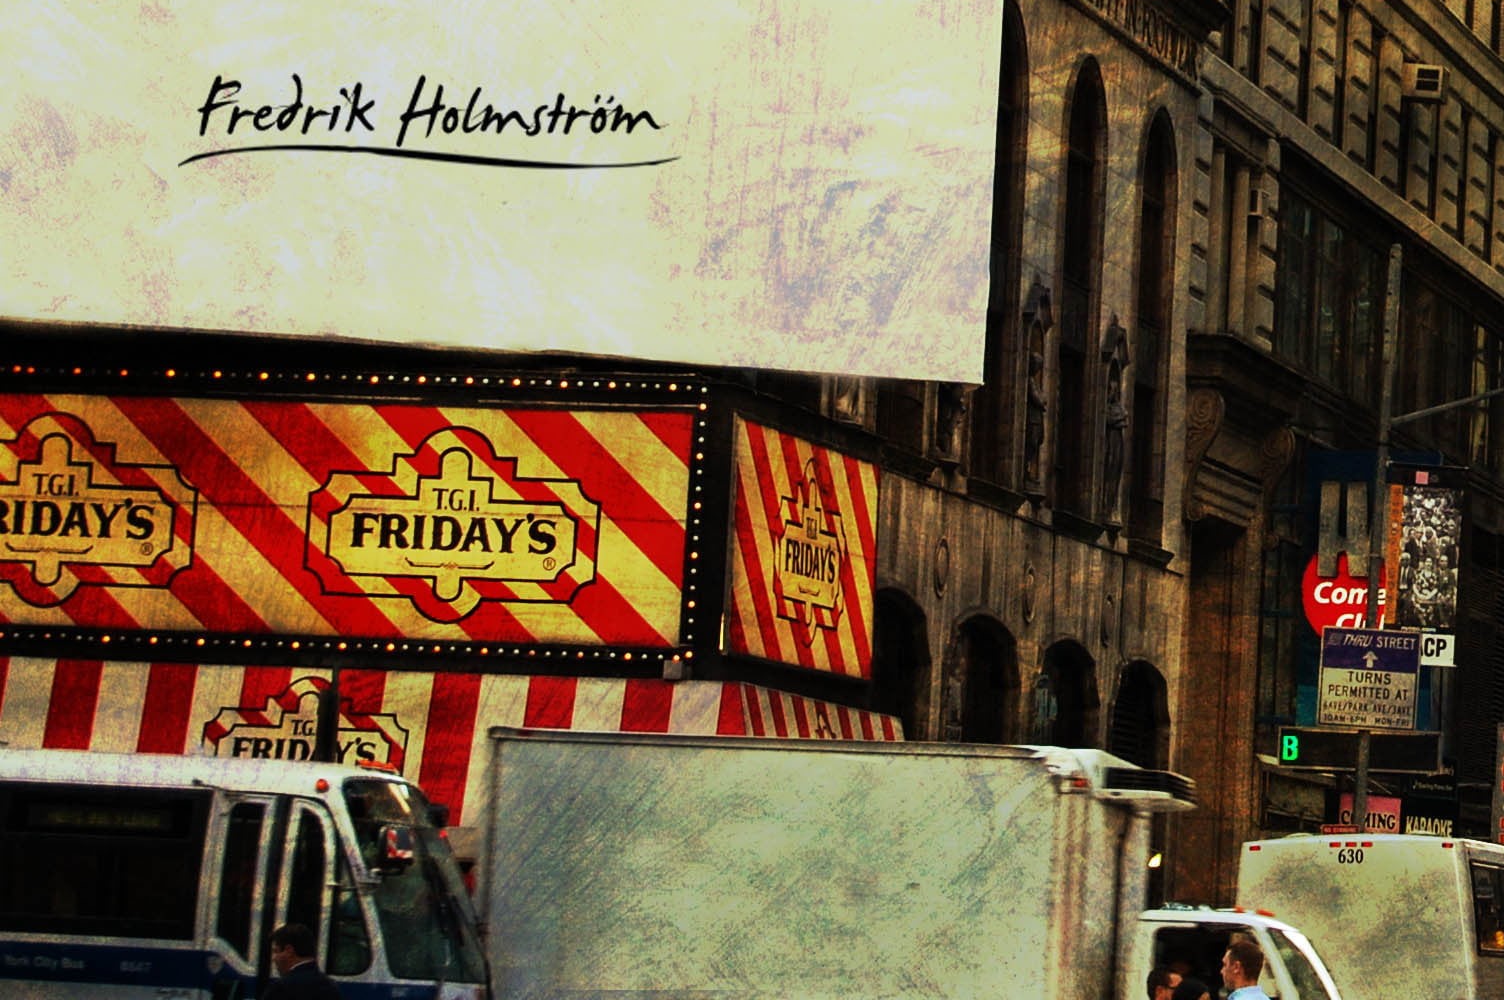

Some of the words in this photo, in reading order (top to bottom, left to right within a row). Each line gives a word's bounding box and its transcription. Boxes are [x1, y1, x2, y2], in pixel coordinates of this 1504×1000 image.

[197, 73, 376, 137] Fredrik
[396, 75, 667, 148] Holmström
[32, 473, 80, 497] T.G.I.
[432, 488, 481, 512] T.G.I.
[350, 512, 557, 554] FRIDAY'S
[784, 537, 837, 585] FRIDAY'S
[1343, 633, 1374, 648] THRU
[1376, 635, 1417, 651] STREET
[1348, 671, 1392, 685] TURNS
[1328, 684, 1391, 700] PERMITTED
[1395, 689, 1409, 701] AT
[291, 719, 316, 737] T.G.
[1282, 735, 1299, 761] B
[1341, 810, 1396, 830] CING
[1405, 814, 1454, 837] KARAOKE
[1338, 849, 1364, 864] 630
